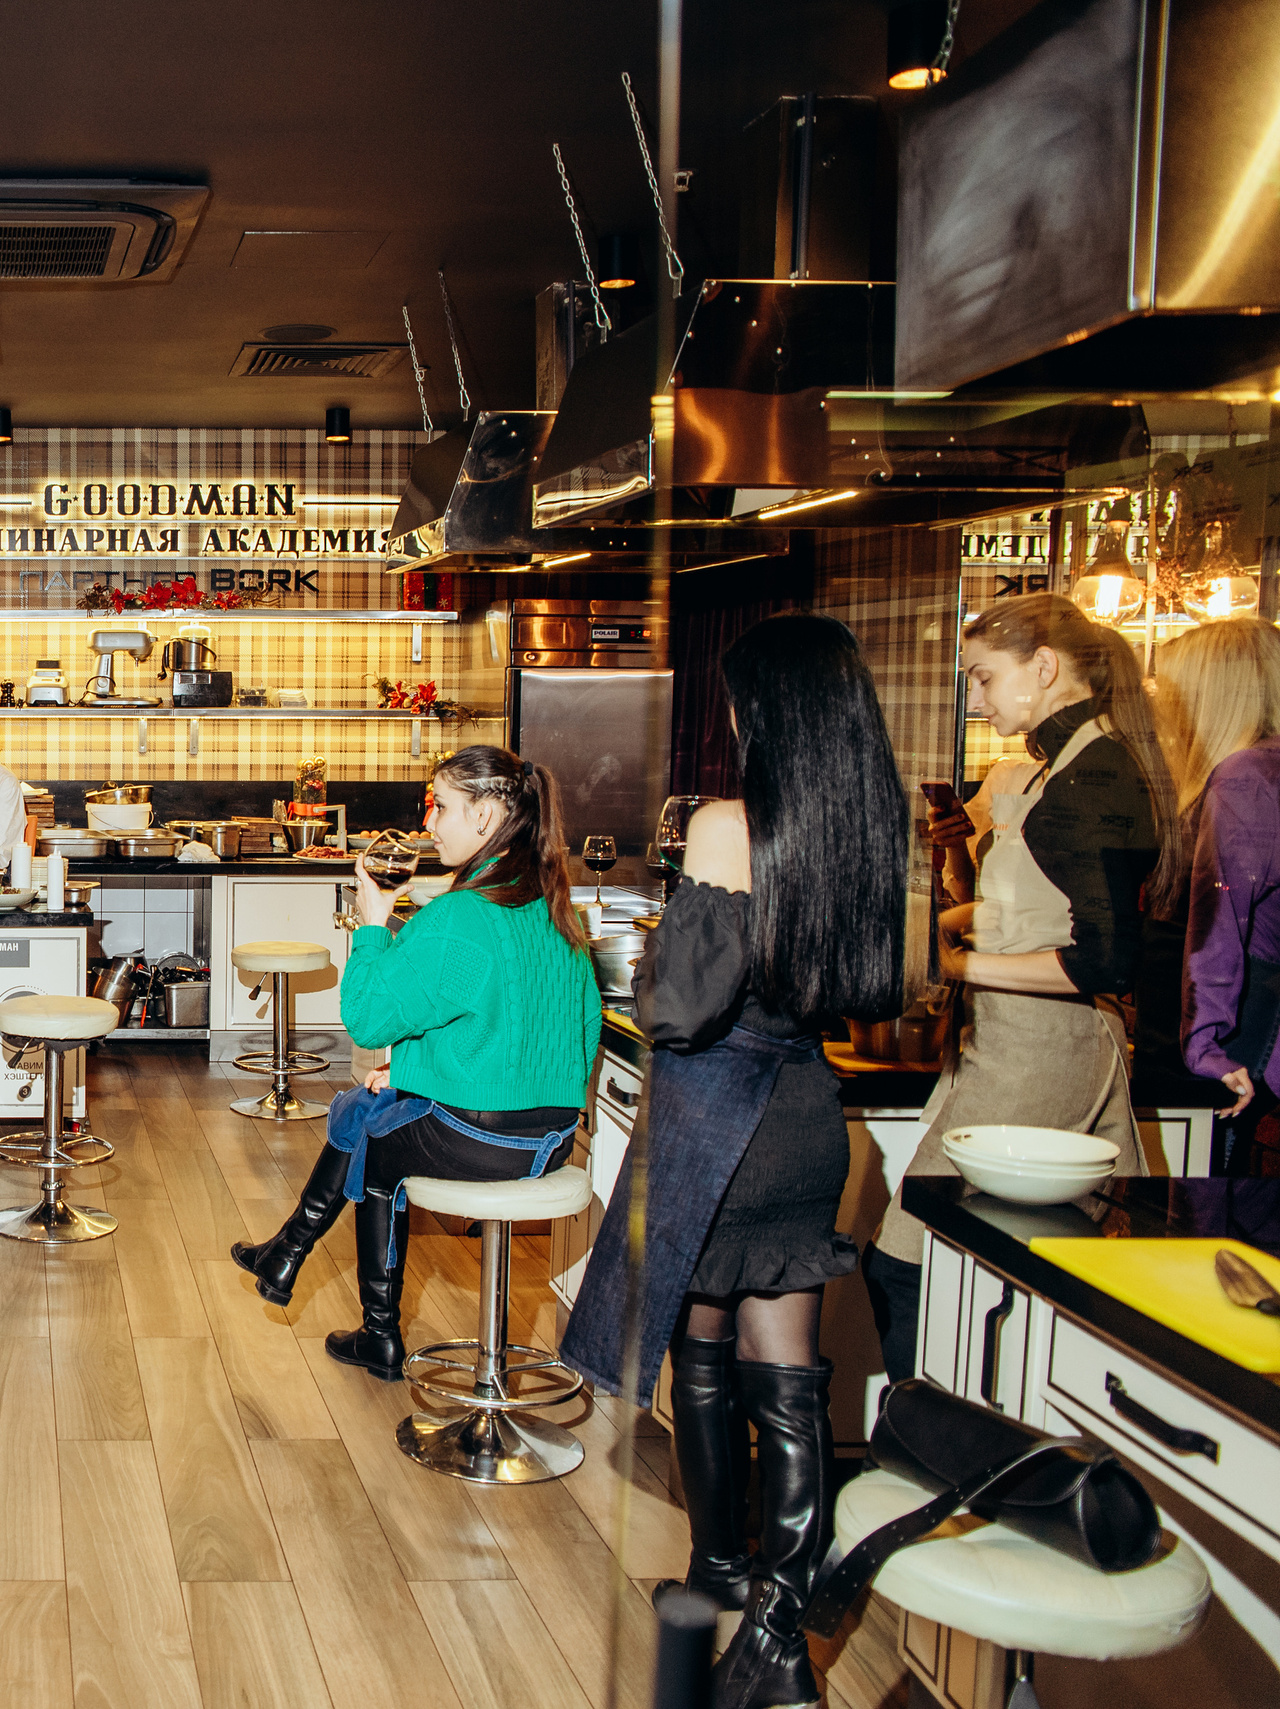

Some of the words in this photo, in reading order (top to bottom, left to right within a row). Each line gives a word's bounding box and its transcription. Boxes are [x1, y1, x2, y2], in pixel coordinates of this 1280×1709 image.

[44, 484, 296, 516] GOODMAN
[210, 568, 320, 593] BORK
[5, 1062, 44, 1070] АВИМ
